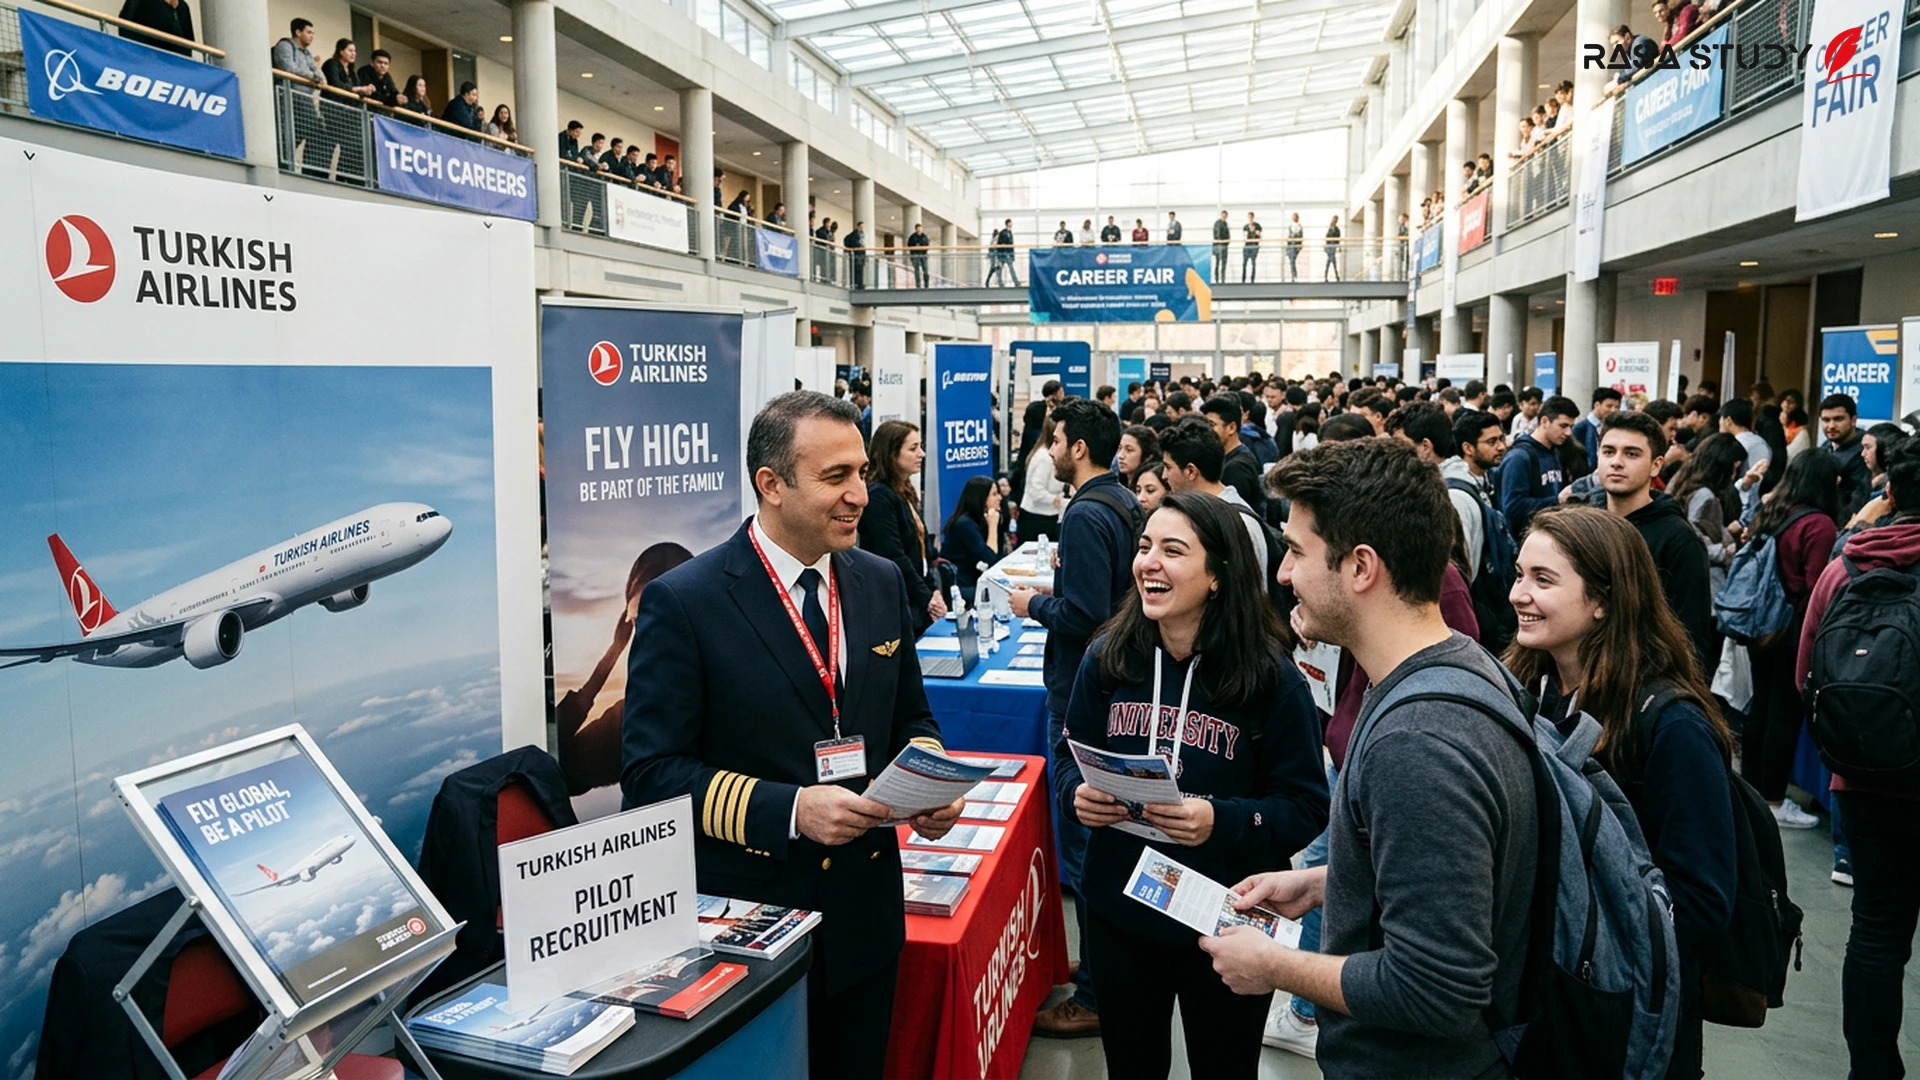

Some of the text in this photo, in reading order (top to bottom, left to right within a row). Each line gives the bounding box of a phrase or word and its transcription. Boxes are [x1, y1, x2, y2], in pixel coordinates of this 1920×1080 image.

[1815, 10, 1890, 73] CER
[95, 67, 227, 116] BOEING
[1812, 54, 1881, 128] FAIR
[385, 141, 528, 198] TECH CAREERS
[133, 226, 292, 273] TURKISH
[136, 270, 297, 312] AIRLINES
[1056, 268, 1175, 286] CAREER FAIR
[629, 344, 707, 363] TURKISH
[630, 365, 708, 383] AIRLINES
[1824, 363, 1890, 383] CAREER
[585, 423, 718, 471] FLY HIGH.
[945, 419, 987, 444] TECH
[945, 446, 989, 463] CAREERS
[580, 471, 725, 502] BE PART OF THE FAMILY
[274, 520, 370, 566] TURKISH AIRLINES
[186, 780, 291, 824] FLY GLOBAL,
[200, 800, 290, 845] BE A PILOT
[517, 820, 677, 880] TURKISH AIRLINES
[575, 874, 634, 914] PILOT
[530, 891, 678, 962] RECRUITMENT
